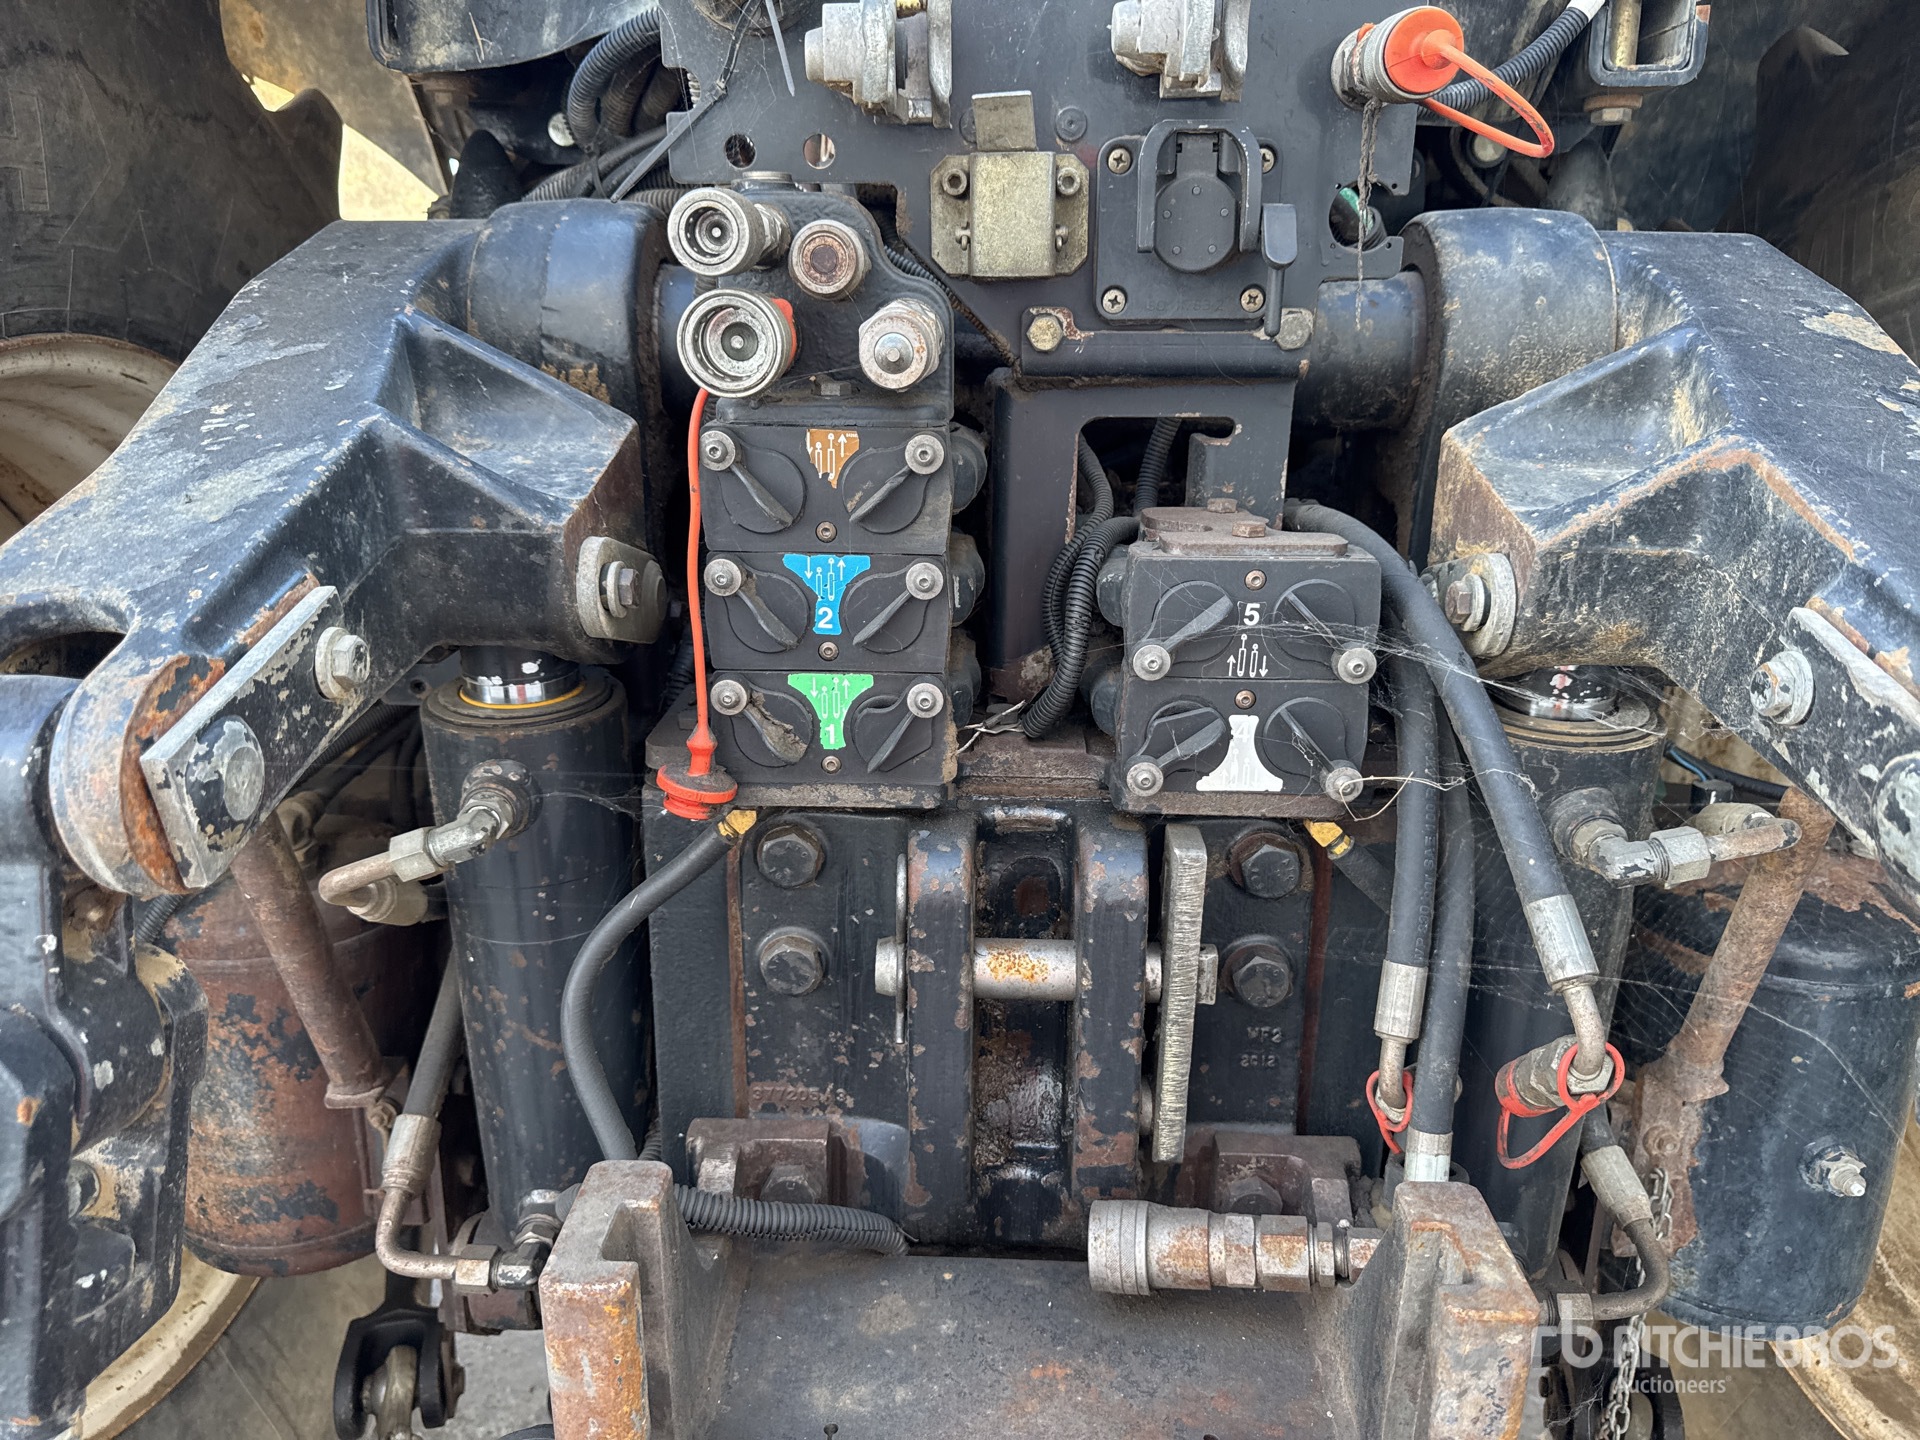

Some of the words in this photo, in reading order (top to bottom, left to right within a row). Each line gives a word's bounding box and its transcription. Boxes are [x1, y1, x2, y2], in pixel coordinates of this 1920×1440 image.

[817, 606, 834, 629] 2
[1243, 603, 1261, 626] 5
[824, 723, 836, 745] 1
[1234, 721, 1251, 743] 4
